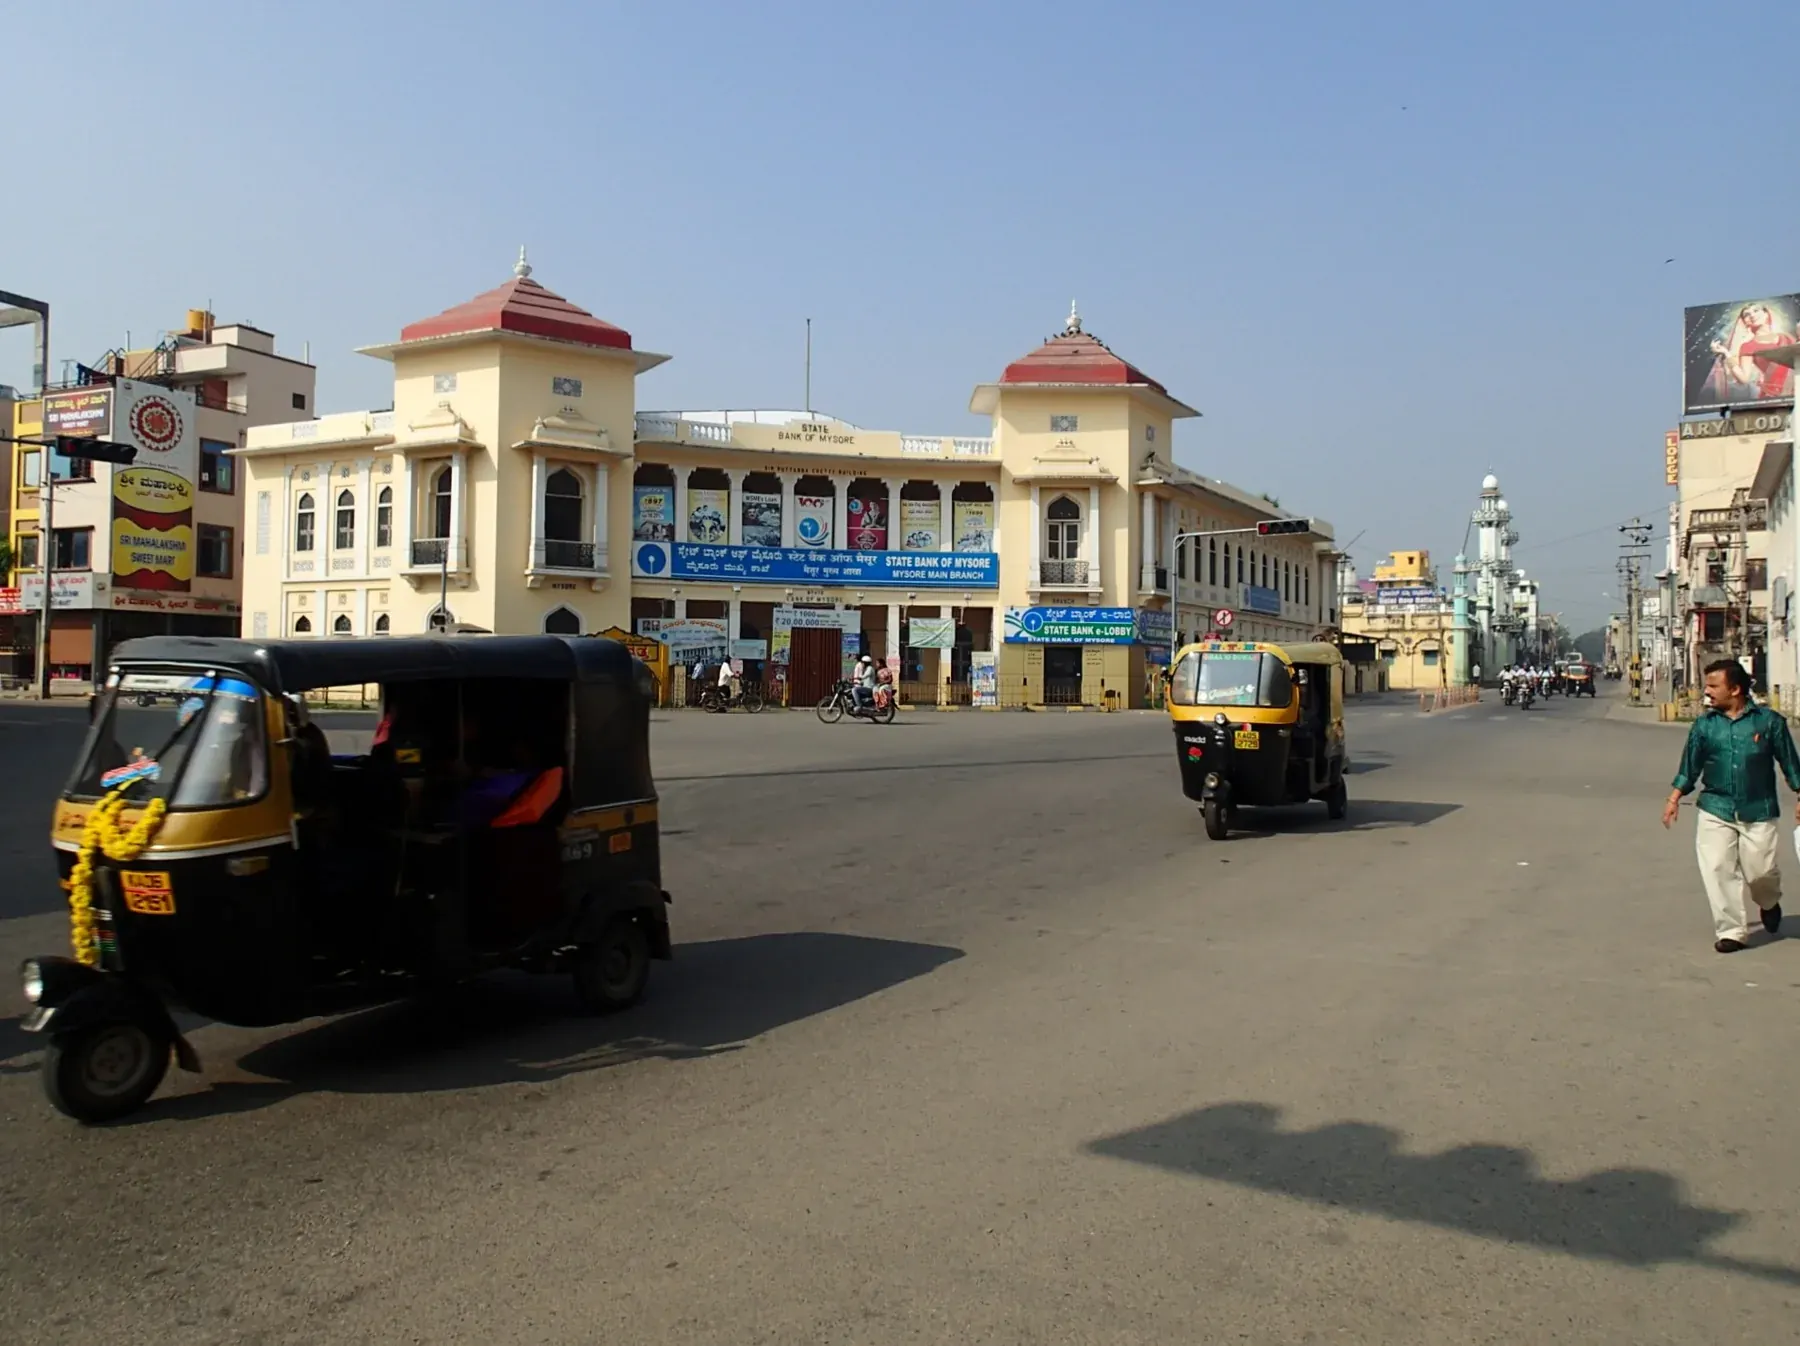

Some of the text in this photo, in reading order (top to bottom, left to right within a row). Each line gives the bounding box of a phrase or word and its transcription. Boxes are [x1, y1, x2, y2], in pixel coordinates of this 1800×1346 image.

[802, 424, 829, 433] STATE
[778, 431, 855, 444] BANK OF MYSORE
[1666, 438, 1678, 484] LODGE
[131, 552, 175, 565] SWEET MART
[751, 549, 782, 563] ಮೈಸೂರು
[788, 550, 806, 561] स्टेट
[808, 550, 826, 562] बैंक
[855, 552, 878, 566] मैसूर
[885, 556, 990, 569] STATE BANK OF MYSORE
[892, 570, 984, 579] MYSORE MAIN BRANCH
[1044, 626, 1132, 636] STATE BANK e-LOBBY
